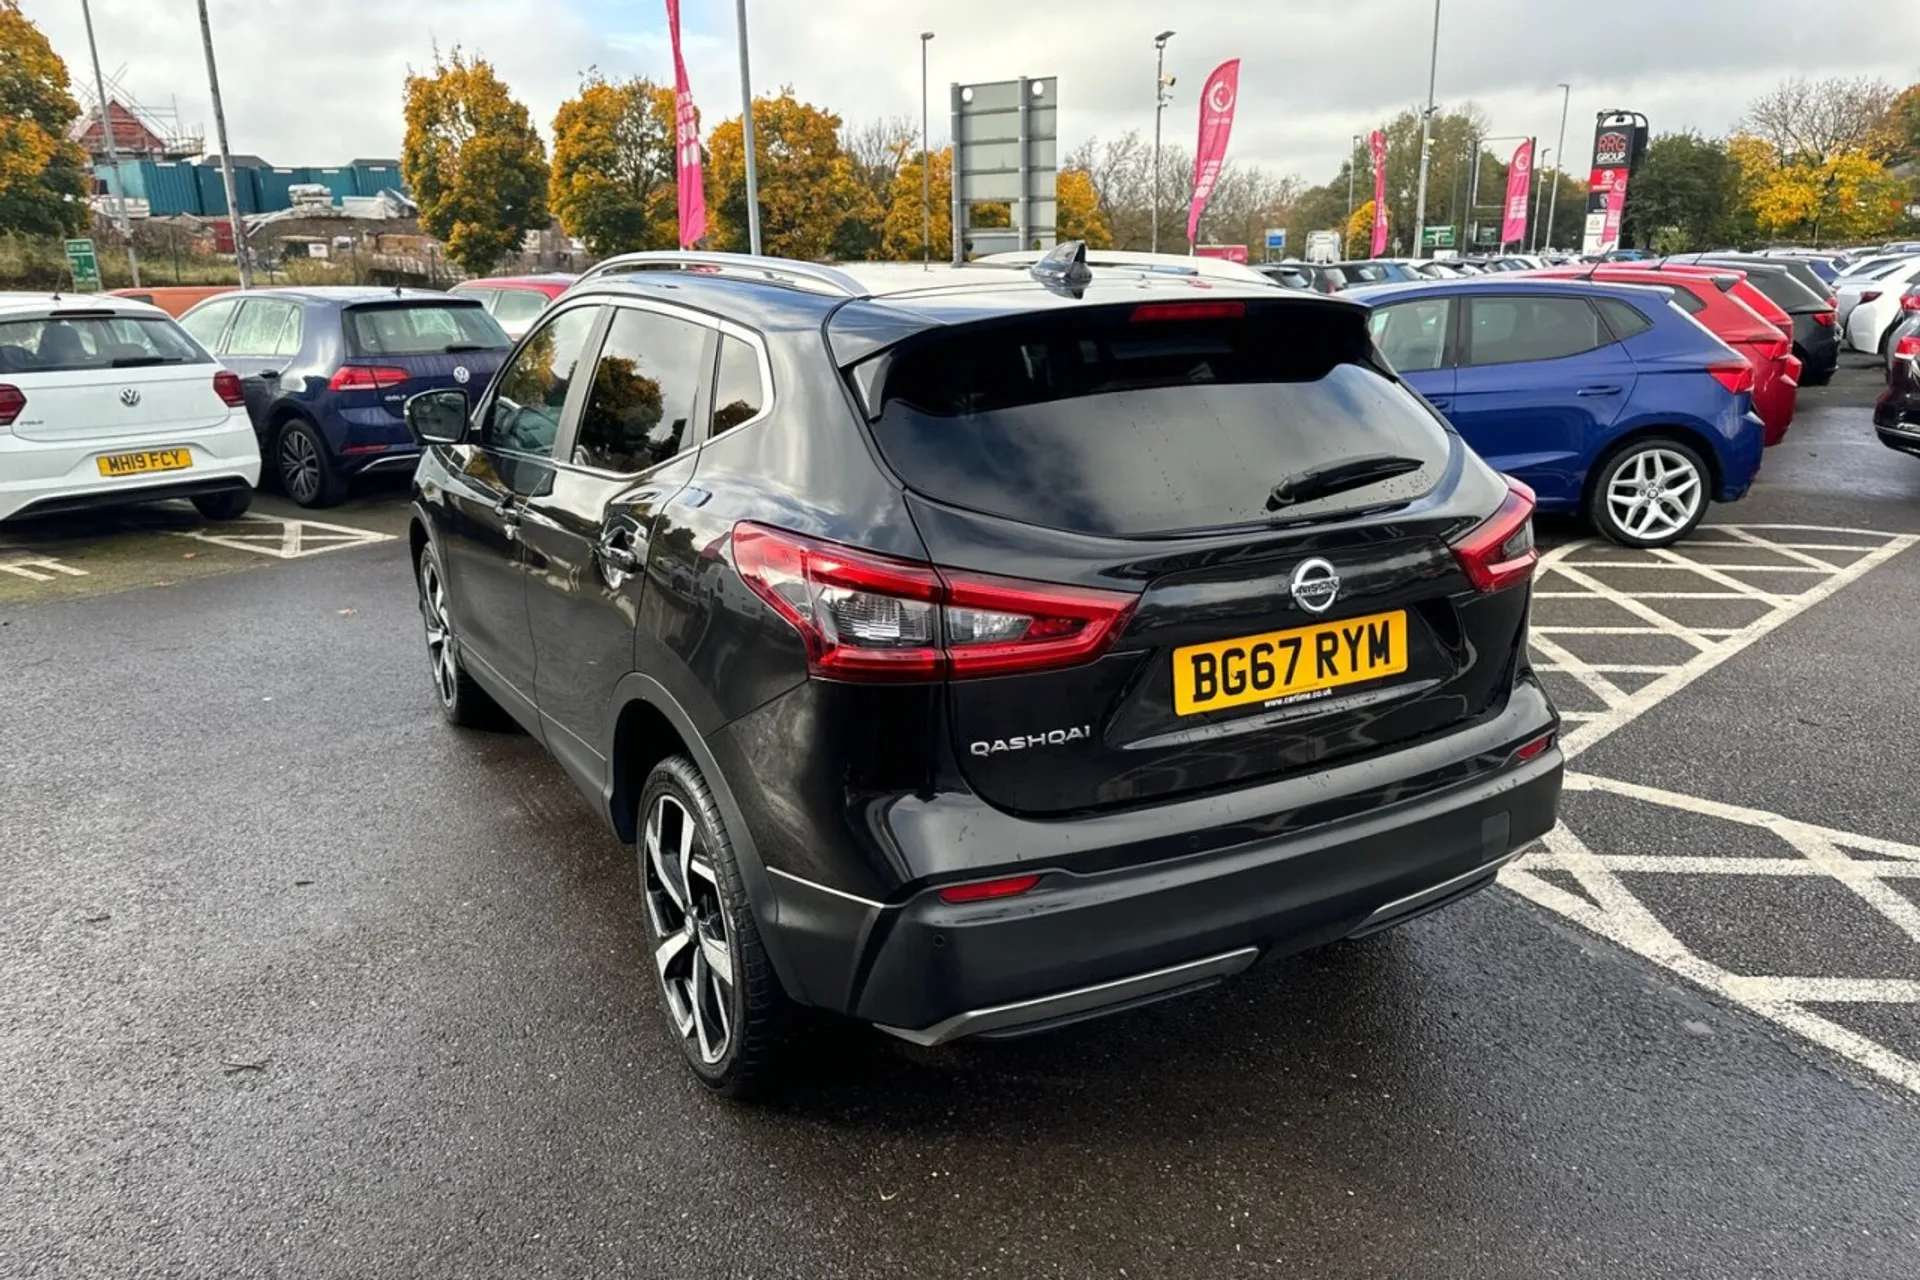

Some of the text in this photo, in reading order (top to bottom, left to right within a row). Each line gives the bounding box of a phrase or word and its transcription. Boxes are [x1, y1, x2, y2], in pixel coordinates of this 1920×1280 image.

[1599, 134, 1626, 152] RRG
[1597, 151, 1626, 161] GROUP
[108, 452, 180, 472] MH19 FCY
[1191, 620, 1390, 703] BG67 RYM
[970, 724, 1091, 757] QASHQAI
